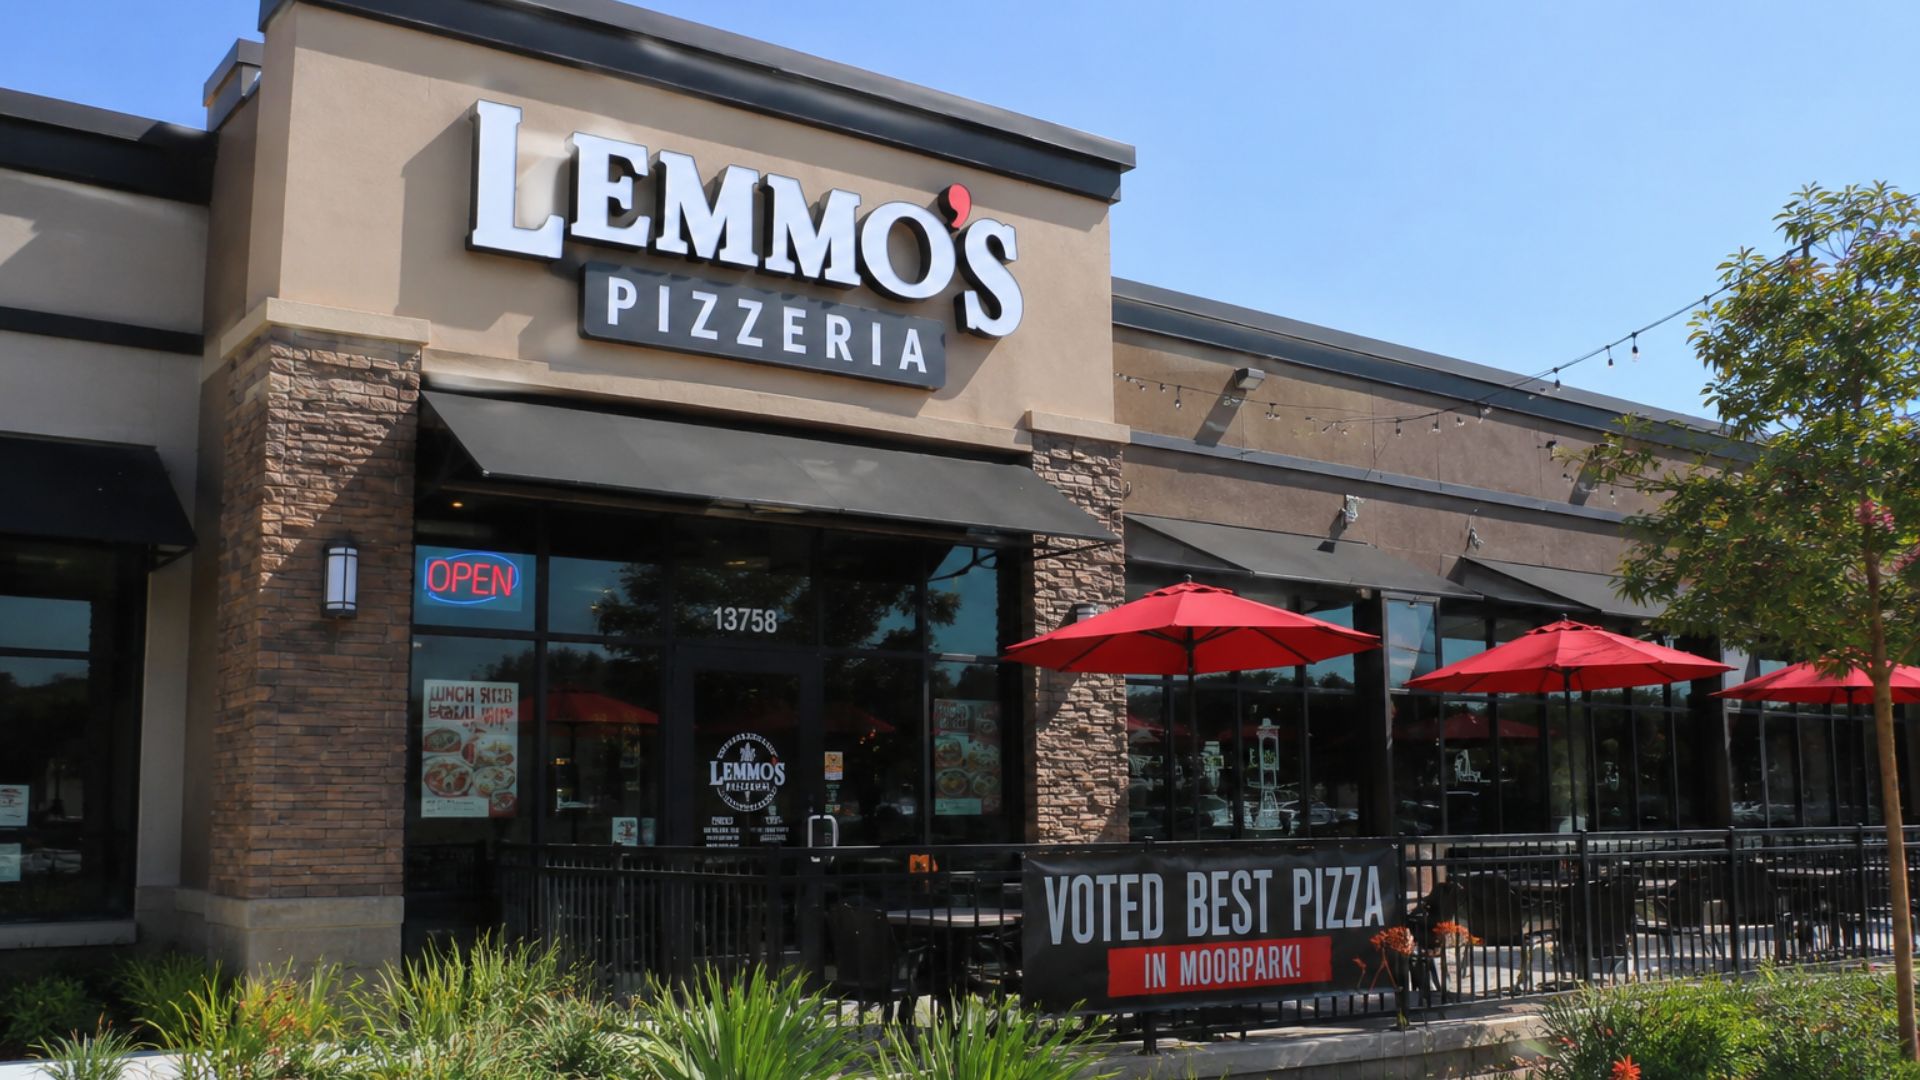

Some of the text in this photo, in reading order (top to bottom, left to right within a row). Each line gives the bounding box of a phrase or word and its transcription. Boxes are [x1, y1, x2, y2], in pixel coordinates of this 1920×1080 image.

[469, 99, 1024, 338] LEMMO'S
[607, 276, 928, 374] PIZZERIA
[428, 559, 513, 597] OPEN
[713, 606, 777, 633] 13758
[1044, 865, 1384, 945] VOTED BEST PIZZA
[1144, 945, 1300, 988] IN MOORPARK!
